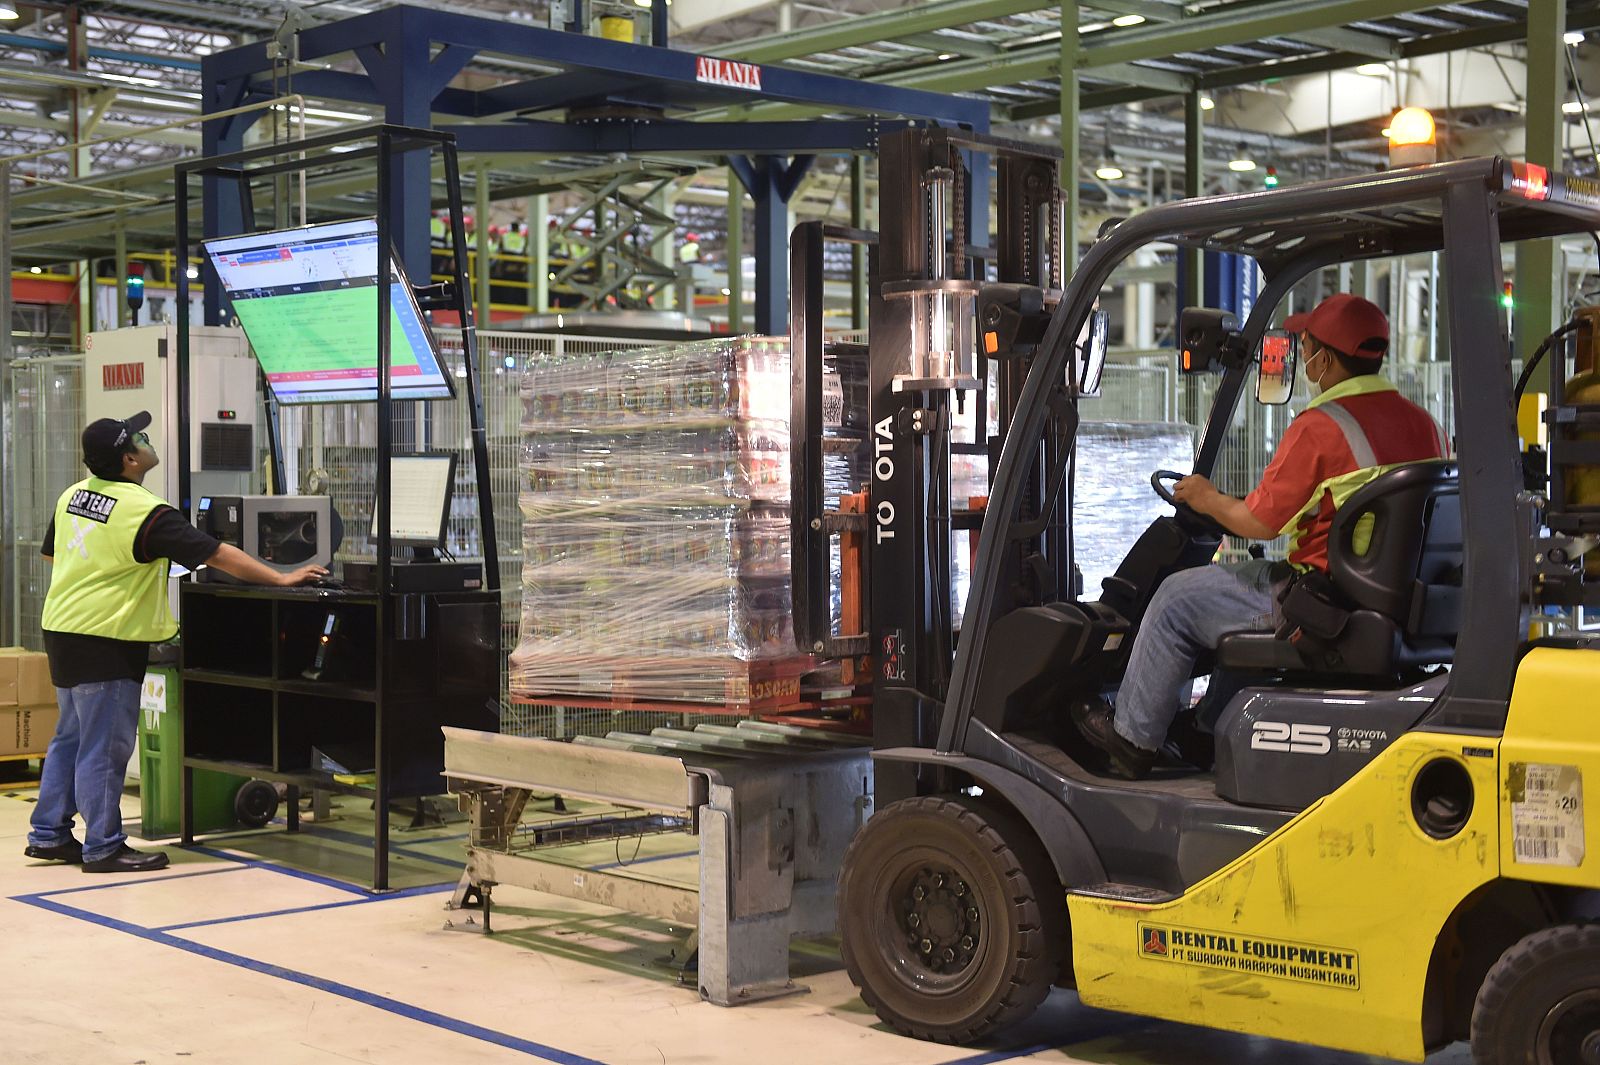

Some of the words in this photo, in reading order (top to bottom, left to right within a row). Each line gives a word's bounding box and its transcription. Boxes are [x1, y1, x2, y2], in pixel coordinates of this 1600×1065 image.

[696, 57, 761, 86] ATLANTA
[103, 363, 144, 387] ATLANTA
[874, 415, 895, 545] TOOTA
[86, 494, 116, 516] TEAM
[23, 710, 31, 748] Machine
[1251, 721, 1331, 755] 25
[1352, 729, 1387, 740] TOYOTA
[1172, 930, 1238, 953] RENTAL
[1243, 940, 1354, 970] EQUIPMENT
[1172, 948, 1184, 960] PT
[1187, 950, 1237, 969] SWADAYA
[1238, 958, 1287, 977] HARAPAN
[1290, 965, 1356, 986] NUSANTARA
